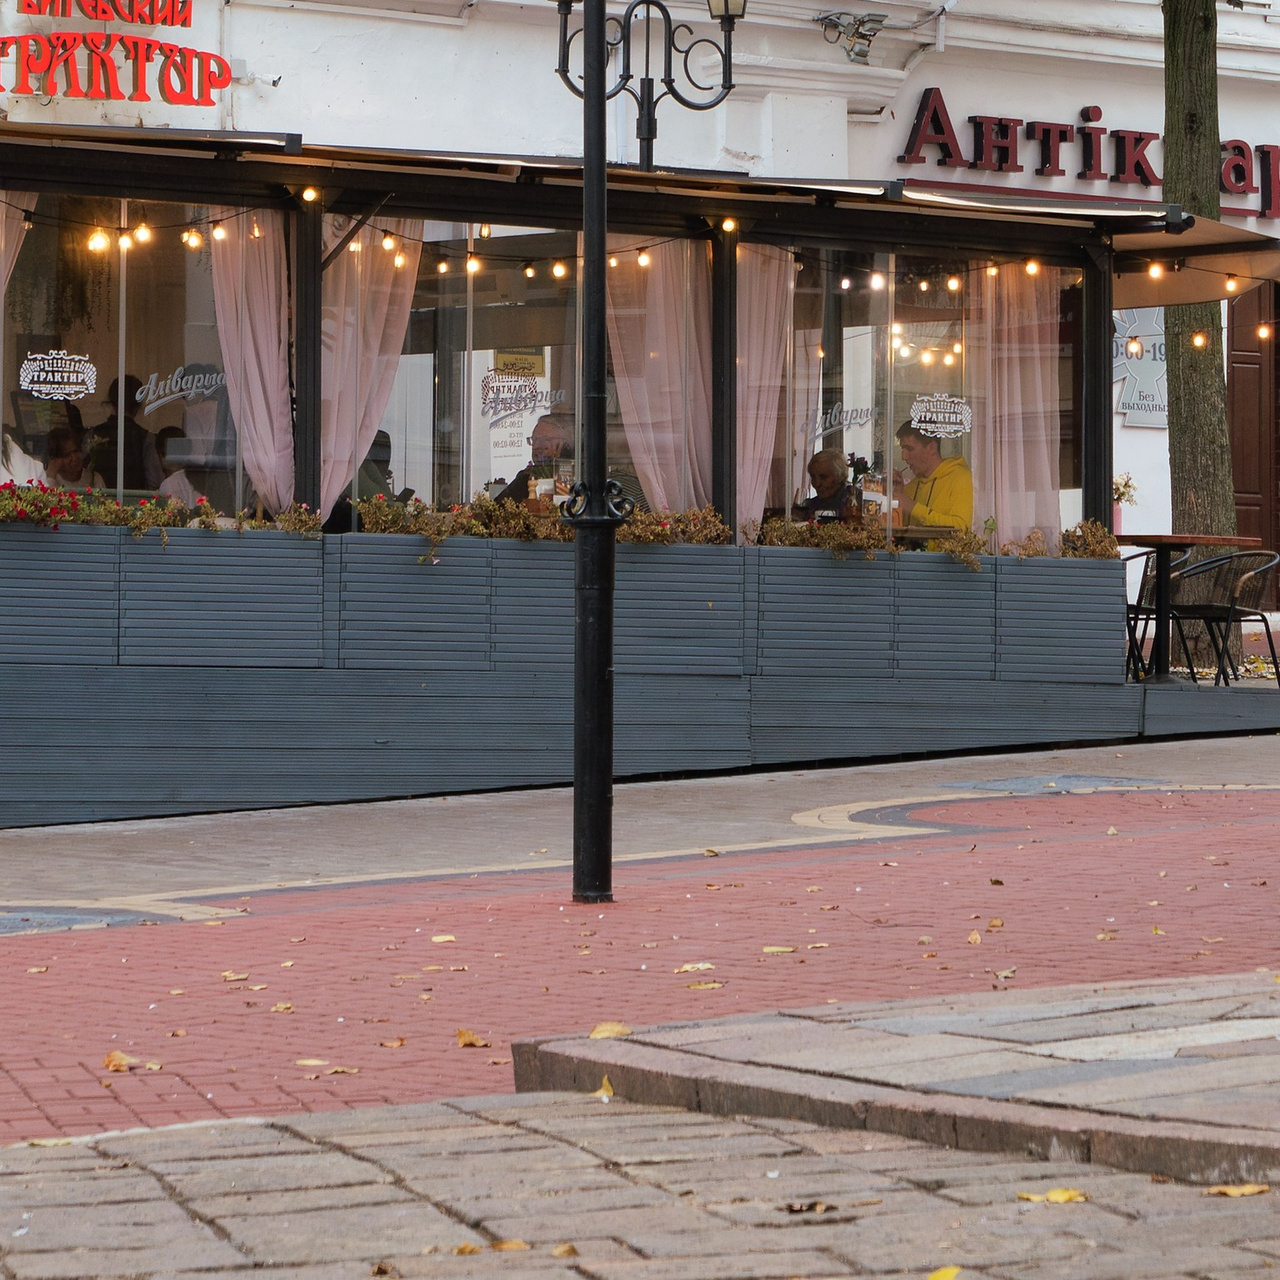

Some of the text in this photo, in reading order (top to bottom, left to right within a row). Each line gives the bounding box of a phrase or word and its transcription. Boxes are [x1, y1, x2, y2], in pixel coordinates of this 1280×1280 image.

[33, 371, 85, 383] ТРАКТИР
[1138, 390, 1155, 402] Без
[1121, 401, 1168, 414] выходны
